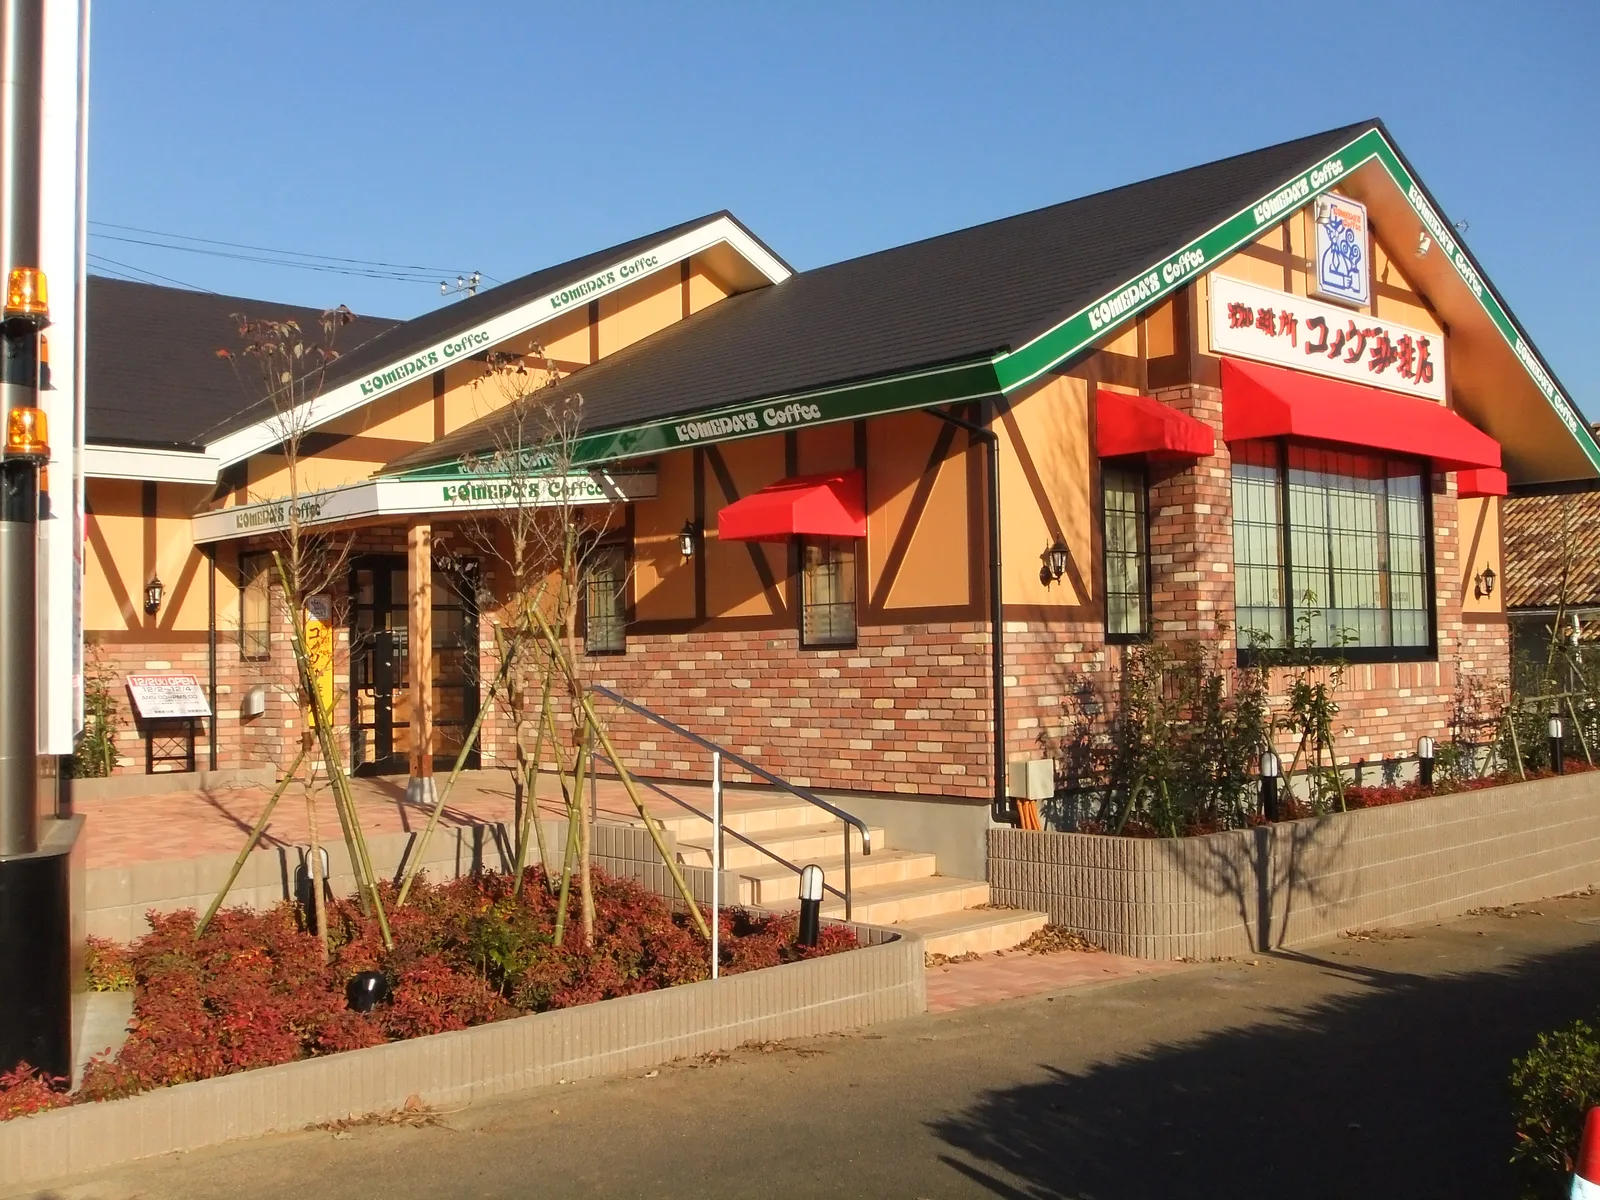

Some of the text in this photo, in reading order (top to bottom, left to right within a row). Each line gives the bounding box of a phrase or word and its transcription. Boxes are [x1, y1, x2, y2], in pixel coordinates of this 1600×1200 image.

[1253, 159, 1344, 225] KOMEDA'S Coffee
[550, 254, 658, 309] KOMEDA'S Coffee
[1088, 248, 1205, 331] KOMEDA'S Coffee
[1455, 253, 1482, 298] Coffee
[360, 331, 490, 396] KOMEDA'S Coffee
[675, 402, 822, 442] KOMEDA'S Coffee
[1554, 395, 1577, 434] Coffee
